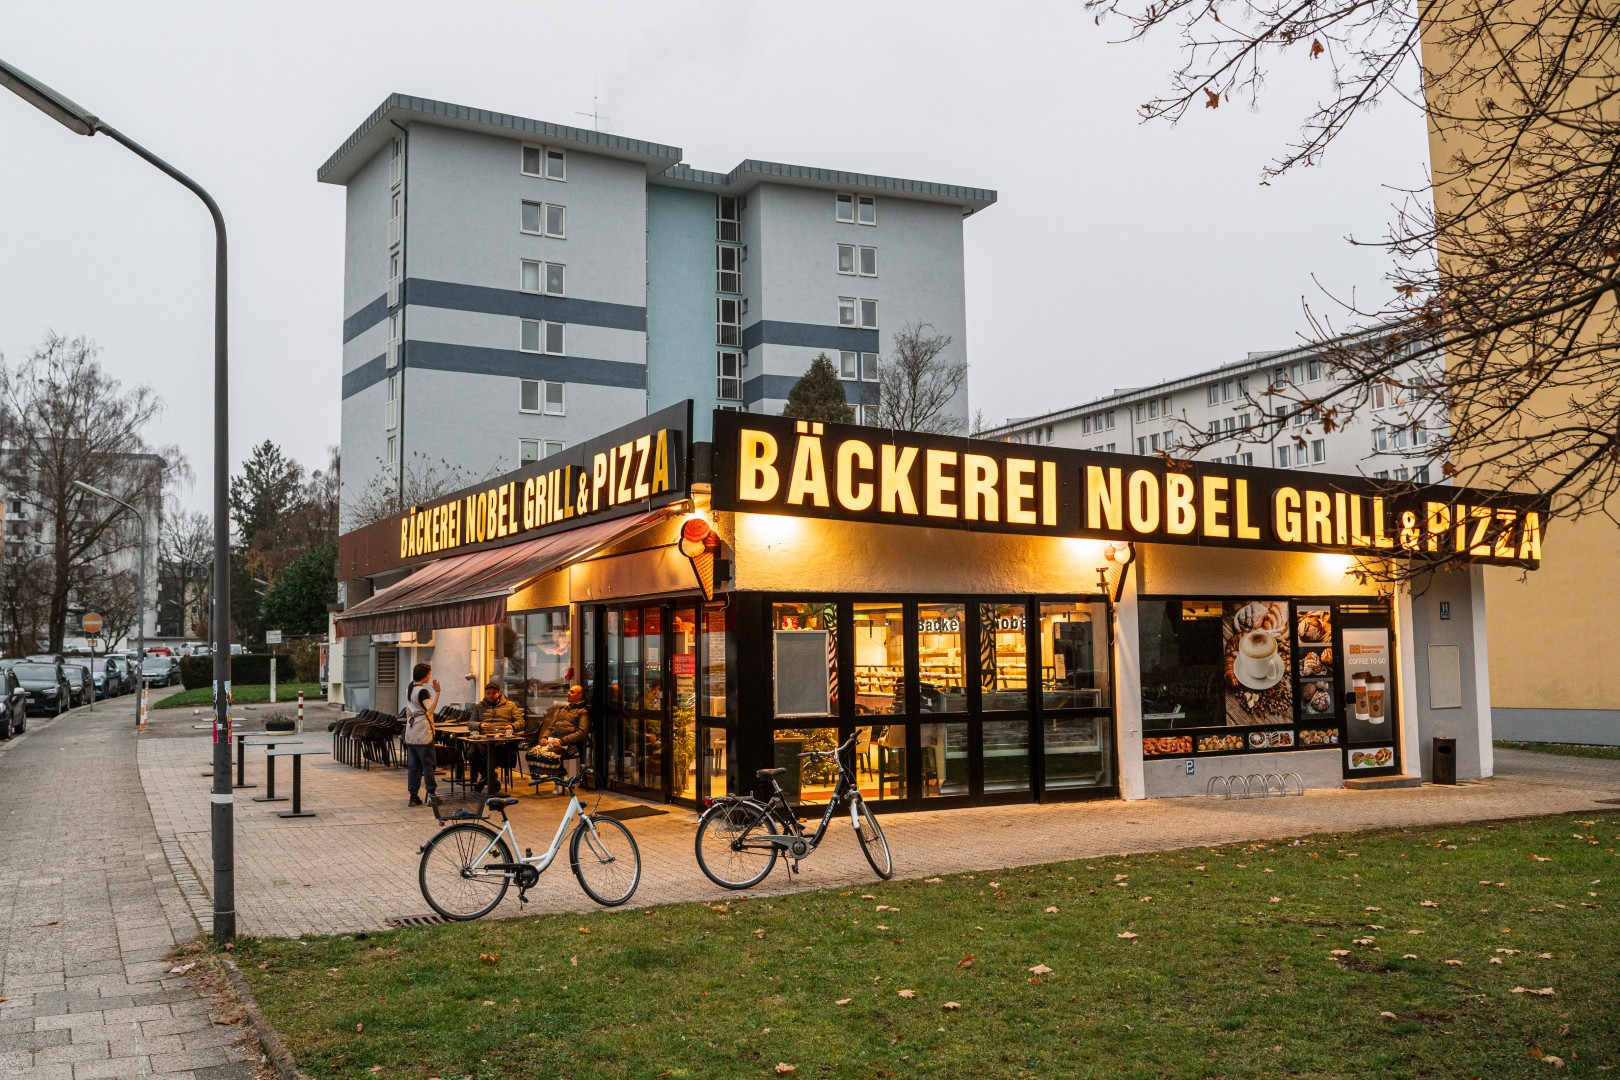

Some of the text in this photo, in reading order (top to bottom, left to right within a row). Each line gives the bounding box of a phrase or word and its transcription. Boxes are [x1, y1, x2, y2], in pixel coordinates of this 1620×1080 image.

[400, 428, 669, 559] BÄCKEREI NOBEL GRILL & PIZZA
[738, 420, 1542, 560] BÄCKEREI NOBEL GRILL & PIZZA
